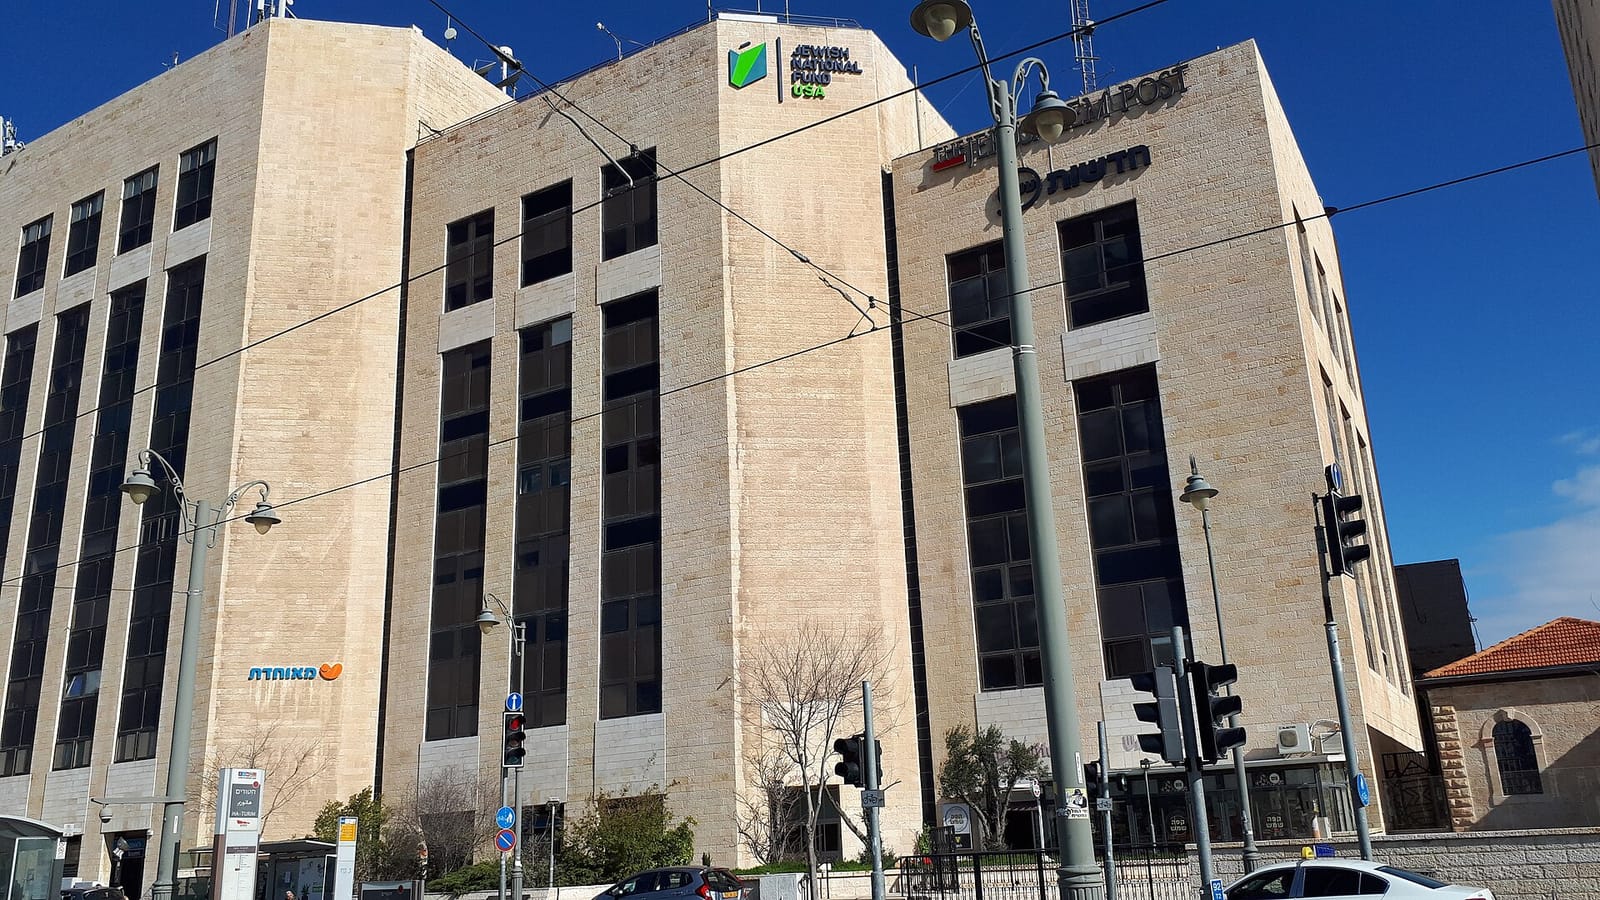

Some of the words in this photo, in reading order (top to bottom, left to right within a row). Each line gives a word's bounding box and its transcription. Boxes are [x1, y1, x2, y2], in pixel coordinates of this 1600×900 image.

[791, 44, 849, 59] JEWISH
[791, 59, 863, 73] NATIONAL
[791, 71, 831, 85] FUND
[791, 84, 826, 98] USA
[1118, 63, 1190, 113] POST
[1046, 144, 1152, 195] חדשות
[248, 667, 317, 681] מאוחדת
